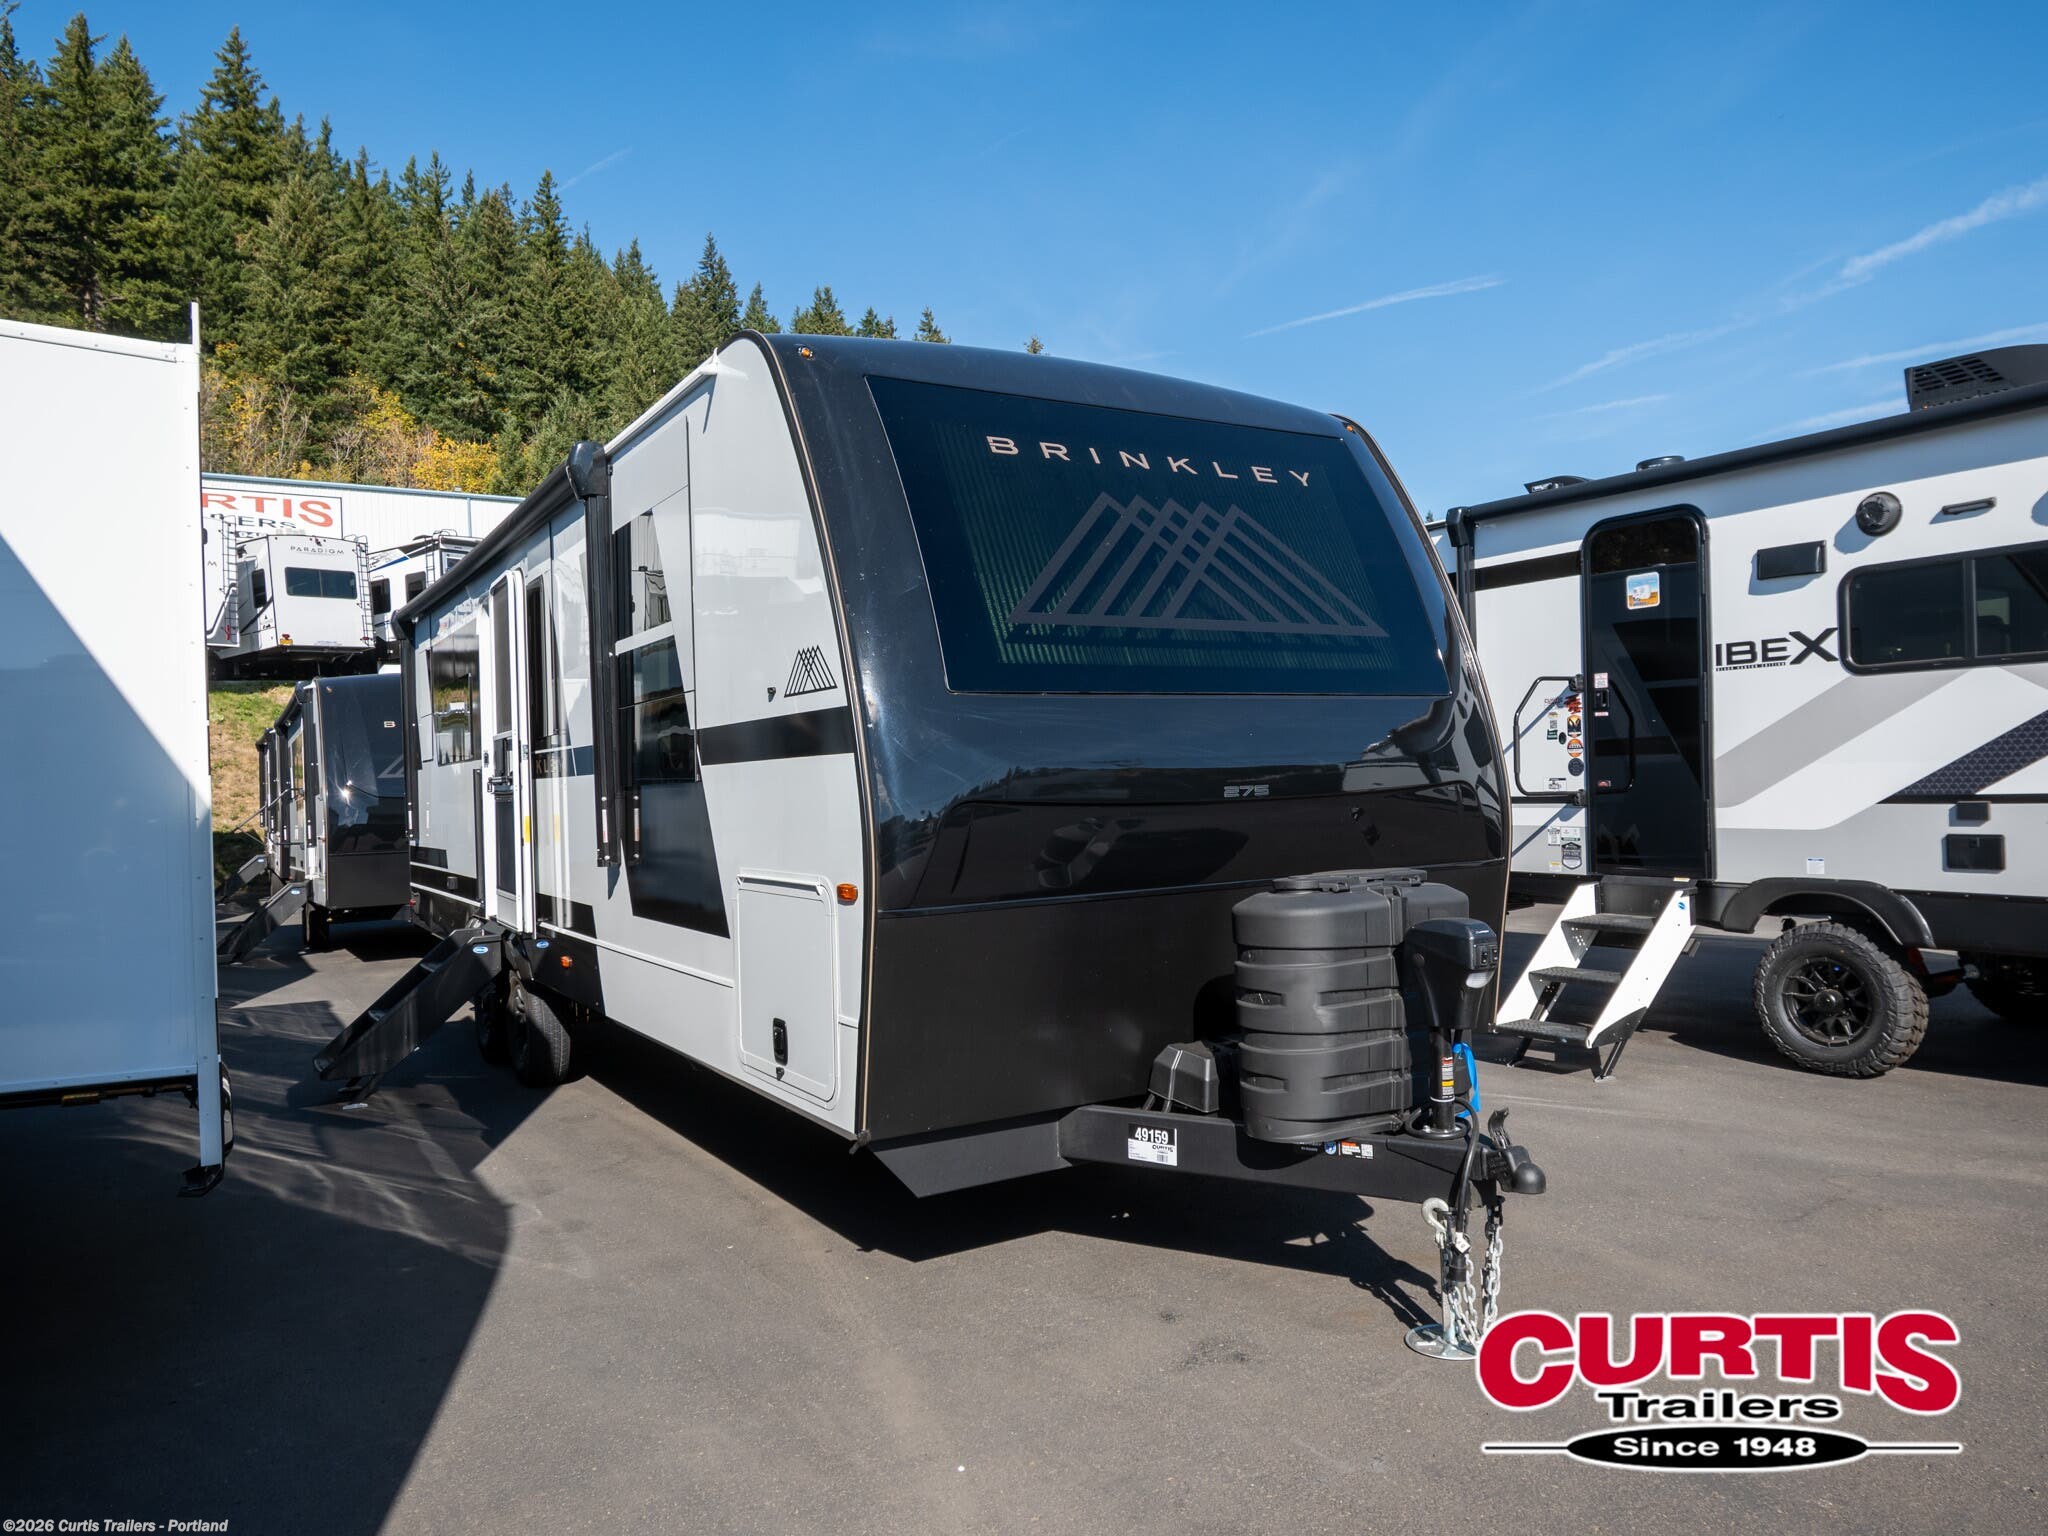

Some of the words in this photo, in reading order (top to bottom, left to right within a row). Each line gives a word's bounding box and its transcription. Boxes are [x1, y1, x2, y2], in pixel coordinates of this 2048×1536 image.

[986, 435, 1310, 487] BRINKLEY
[289, 545, 345, 555] PARADIGM
[1715, 627, 1839, 667] IBEX
[1223, 784, 1270, 798] 275
[1135, 1126, 1169, 1145] 49159
